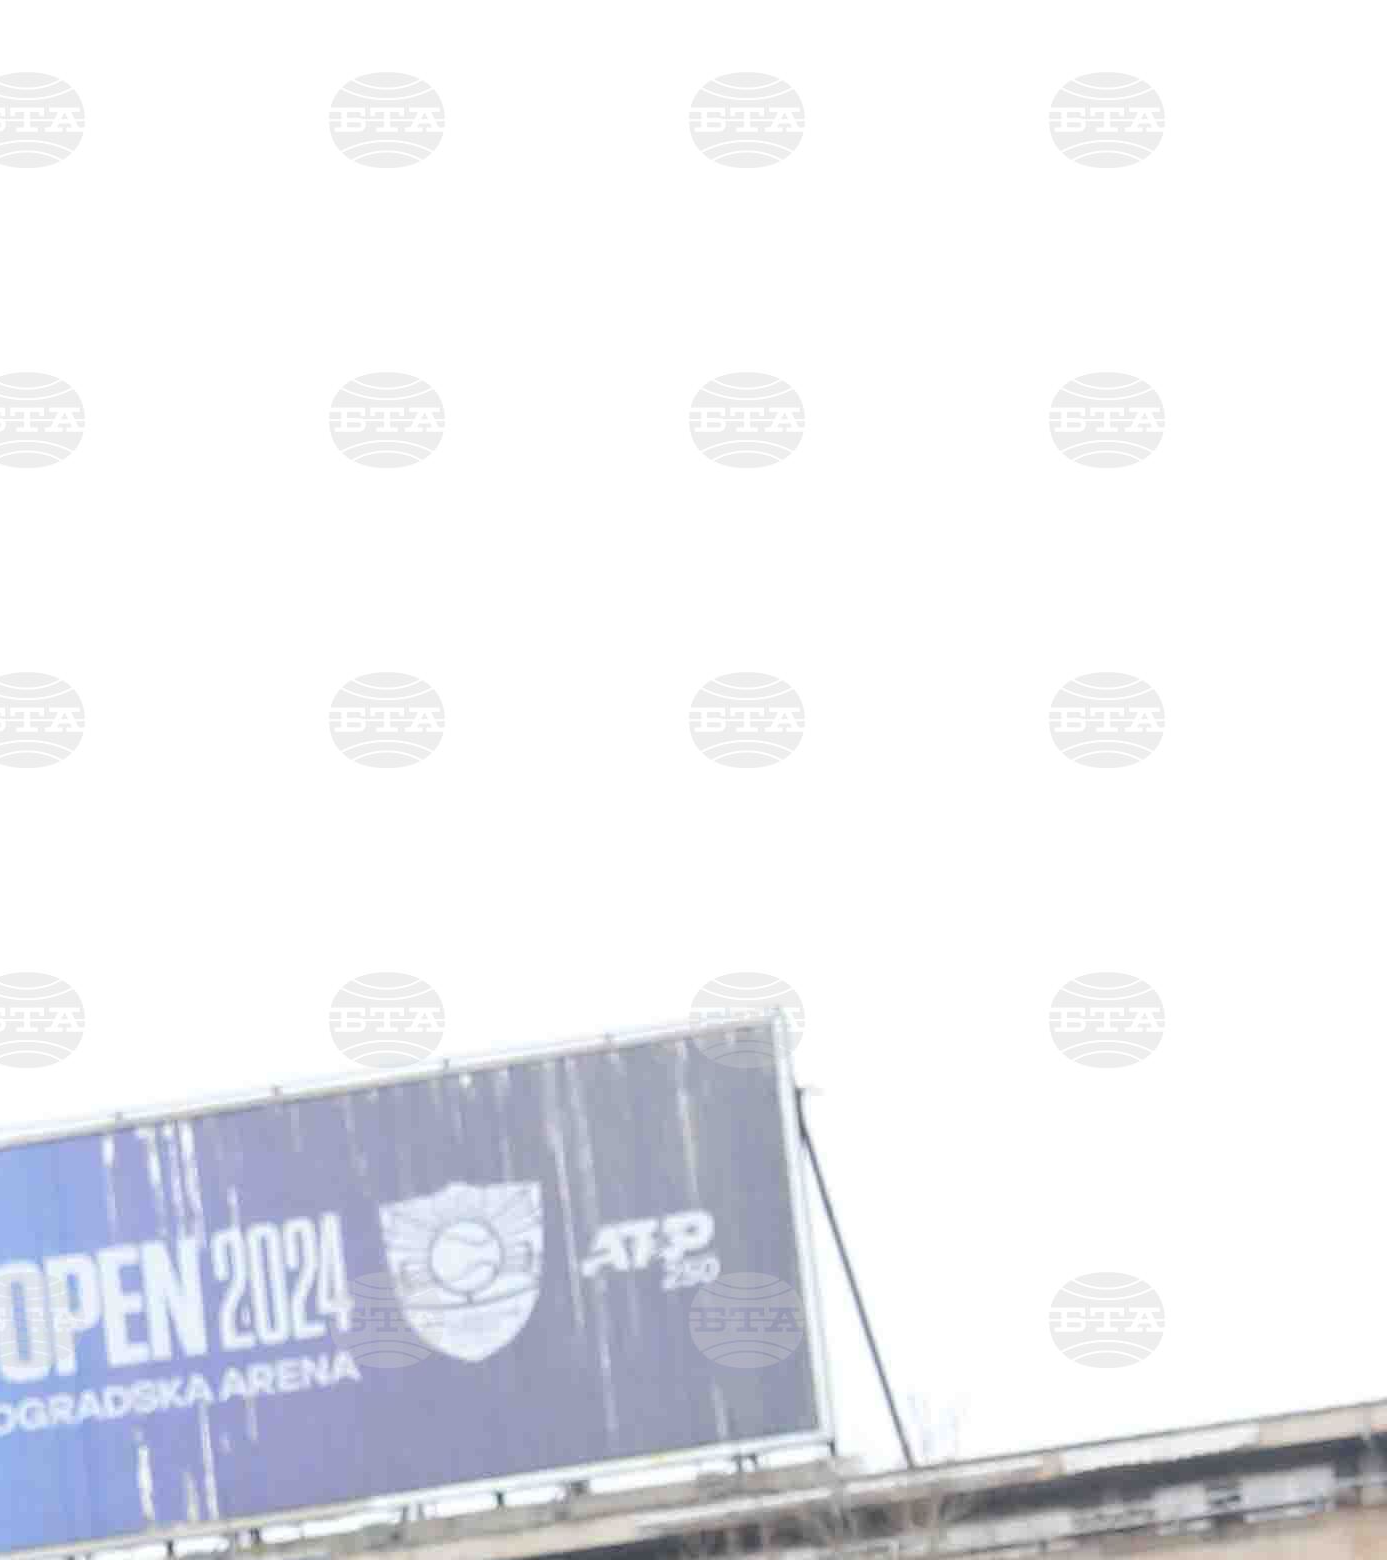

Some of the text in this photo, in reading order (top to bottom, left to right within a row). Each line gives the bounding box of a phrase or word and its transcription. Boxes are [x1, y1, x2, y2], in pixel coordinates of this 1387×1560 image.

[581, 1210, 715, 1278] ATP
[663, 1255, 722, 1292] 250
[211, 1212, 353, 1350] 2024
[218, 1350, 362, 1401] ARENA
